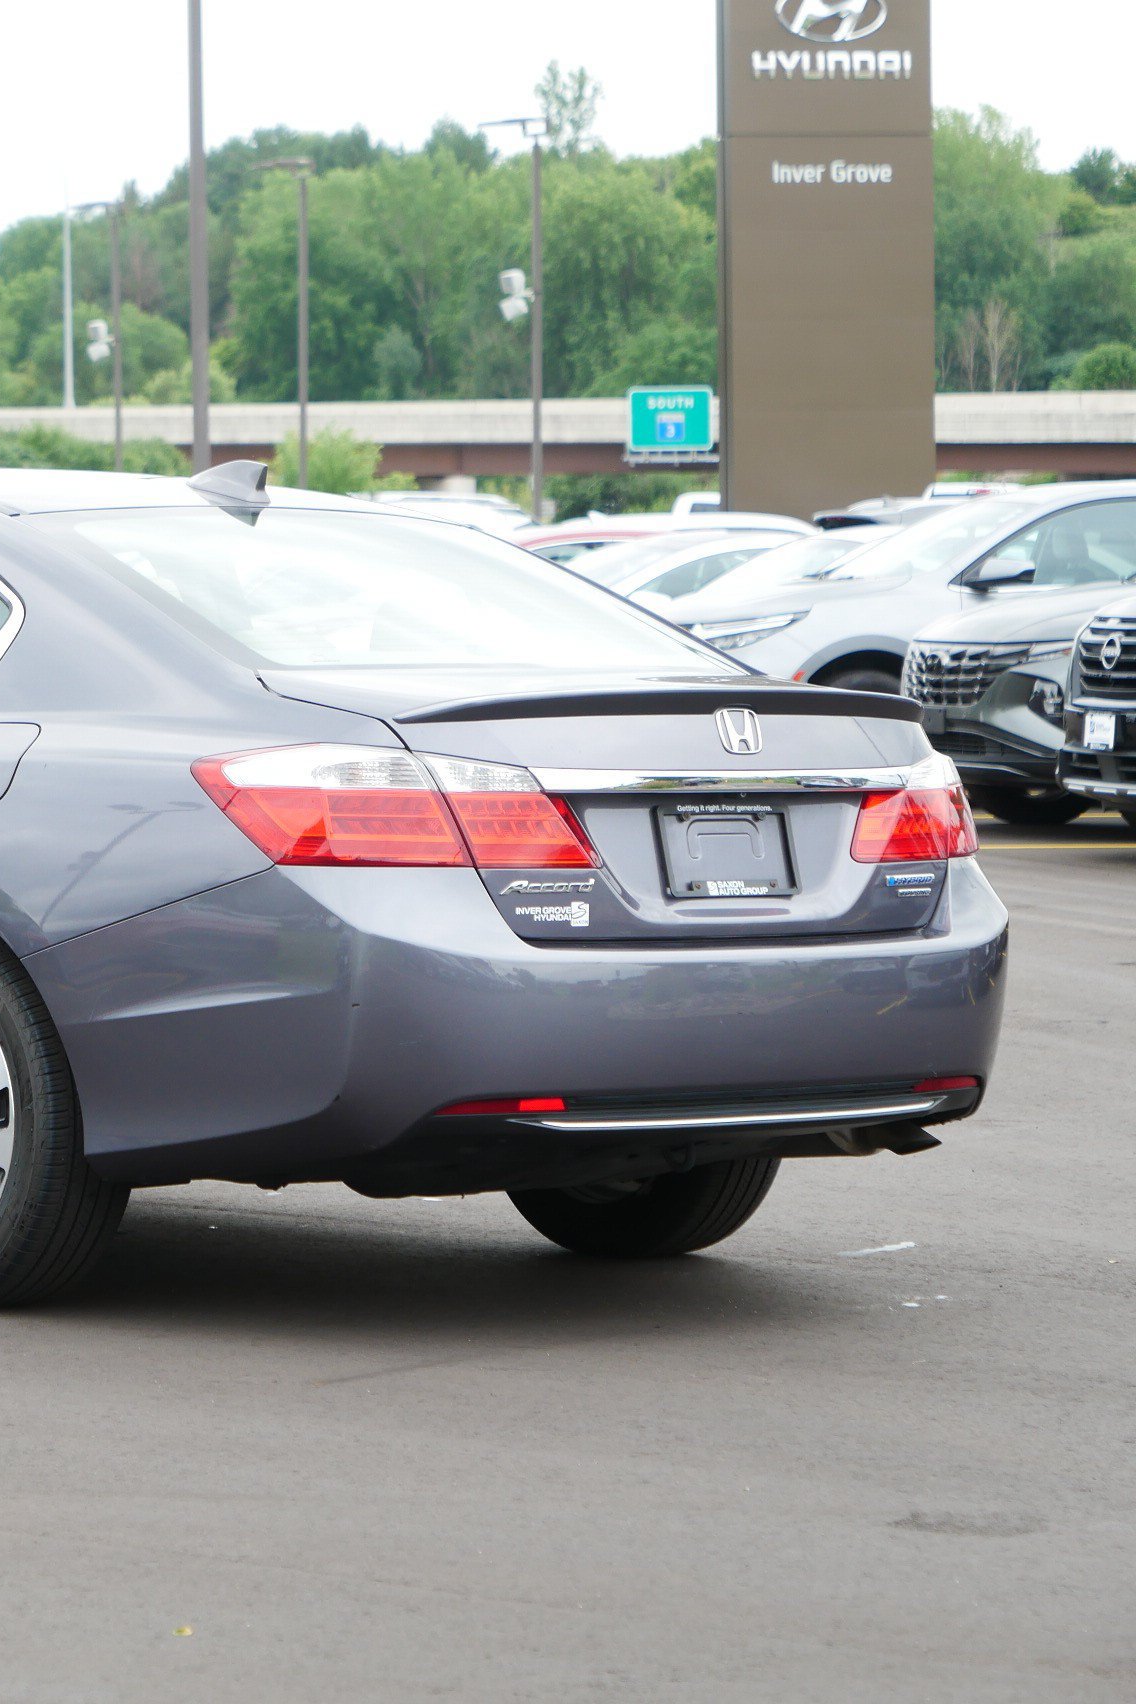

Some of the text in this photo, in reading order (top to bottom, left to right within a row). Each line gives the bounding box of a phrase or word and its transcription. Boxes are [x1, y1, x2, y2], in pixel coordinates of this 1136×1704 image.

[751, 50, 912, 80] HYUNDAI
[772, 159, 892, 183] Inver Grove
[647, 396, 694, 410] SOUTH
[677, 804, 699, 813] Getting
[705, 804, 721, 813] right.
[722, 804, 735, 812] Four
[736, 804, 773, 813] generations.
[499, 878, 595, 895] Accord
[717, 880, 744, 888] SAXON
[719, 887, 768, 896] AUTO GROUP
[515, 906, 571, 915] INVER GROVE
[534, 914, 571, 922] HYUNDAI
